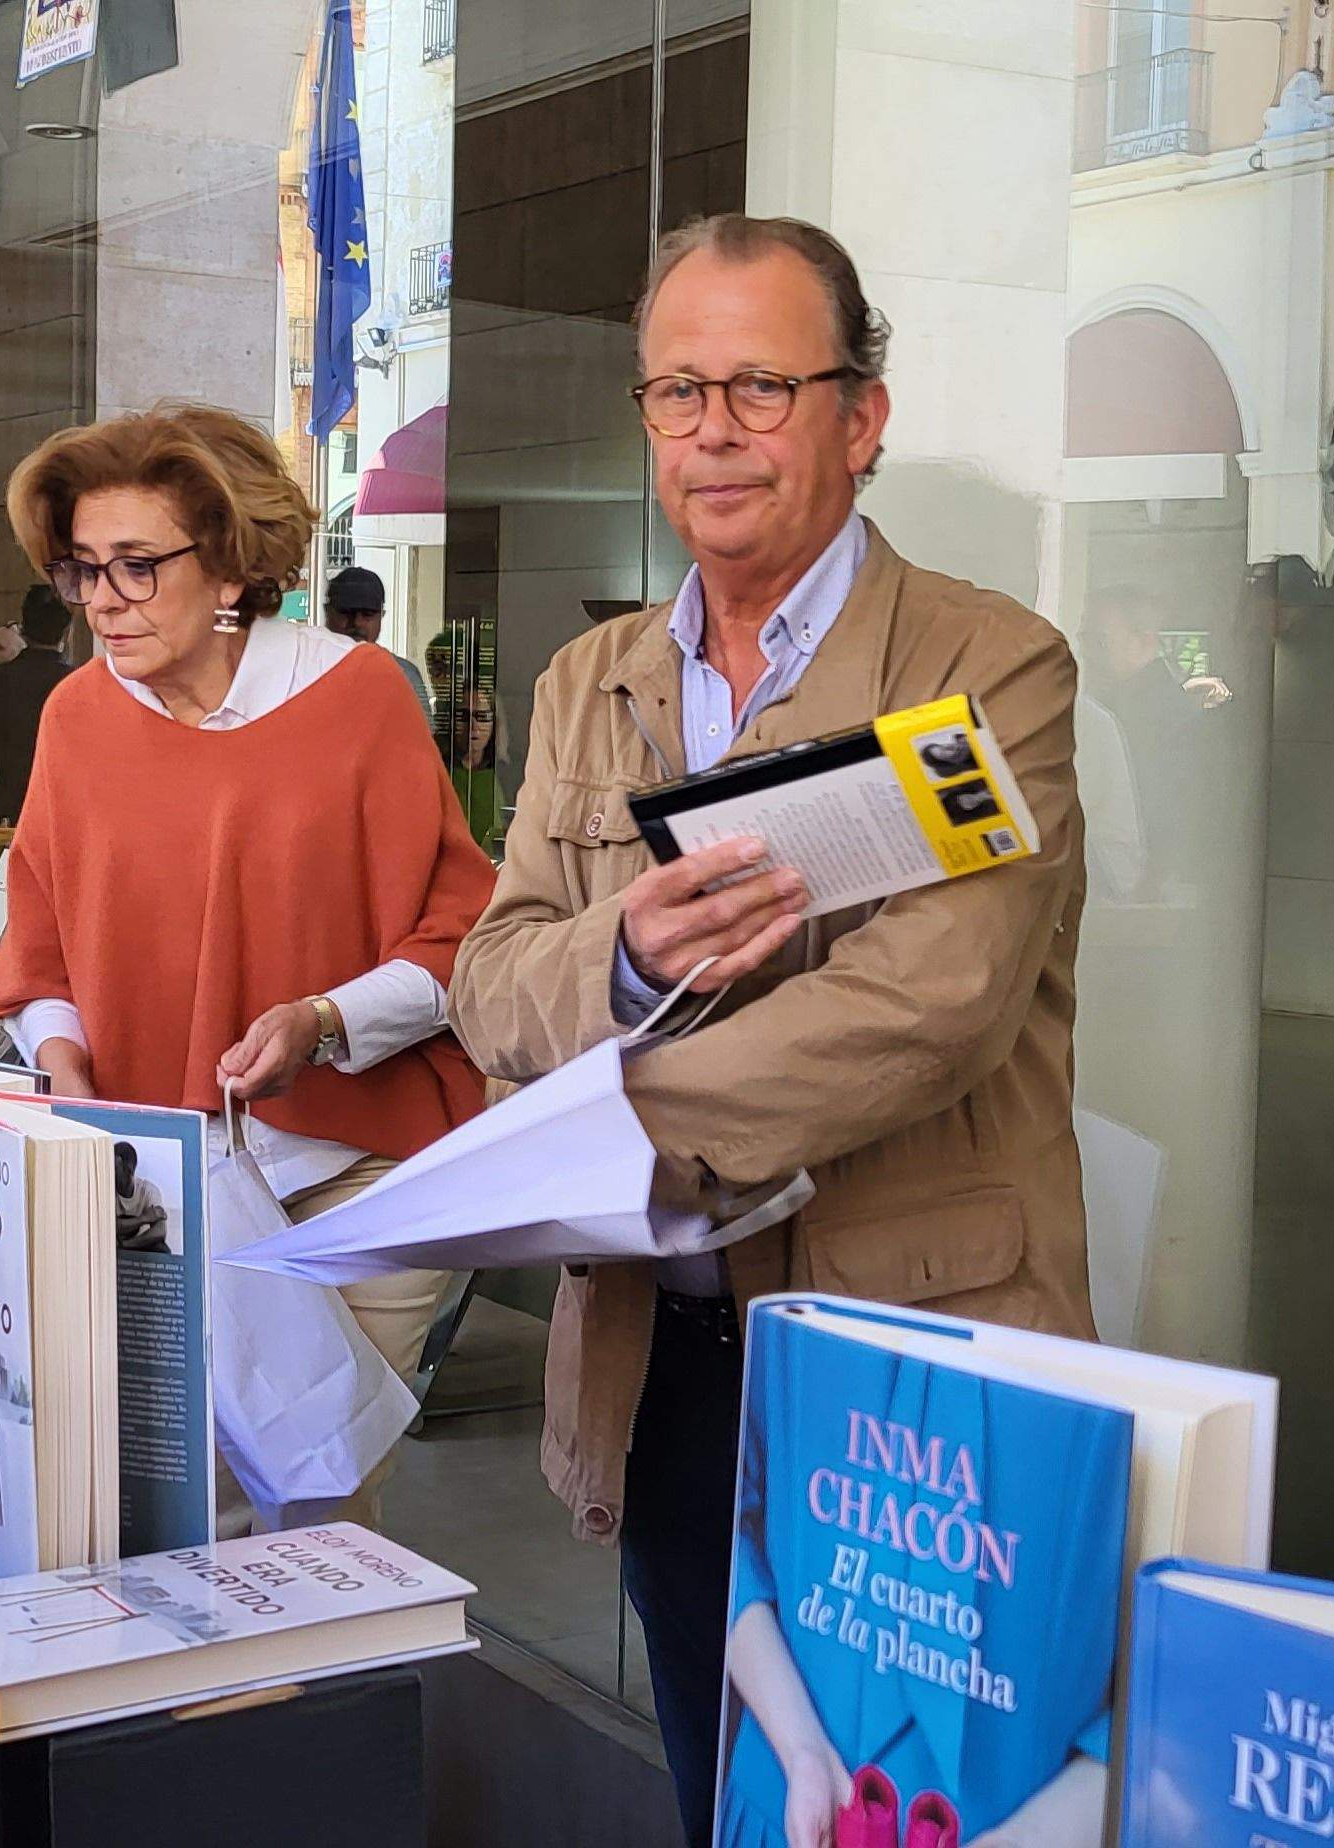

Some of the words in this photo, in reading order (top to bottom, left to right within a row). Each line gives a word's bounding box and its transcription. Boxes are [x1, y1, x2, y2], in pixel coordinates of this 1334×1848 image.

[847, 1407, 984, 1507] INMA
[267, 1542, 365, 1591] CUANDO
[306, 1529, 358, 1548] ELOY
[351, 1549, 423, 1588] MORENO
[808, 1468, 1020, 1591] CHACÓN
[167, 1550, 285, 1615] DIVERTIDO
[240, 1561, 299, 1588] ERA
[829, 1543, 870, 1595] El
[870, 1565, 984, 1641] cuarto
[797, 1584, 836, 1635] de
[837, 1603, 872, 1654] la
[875, 1621, 1017, 1712] plancha
